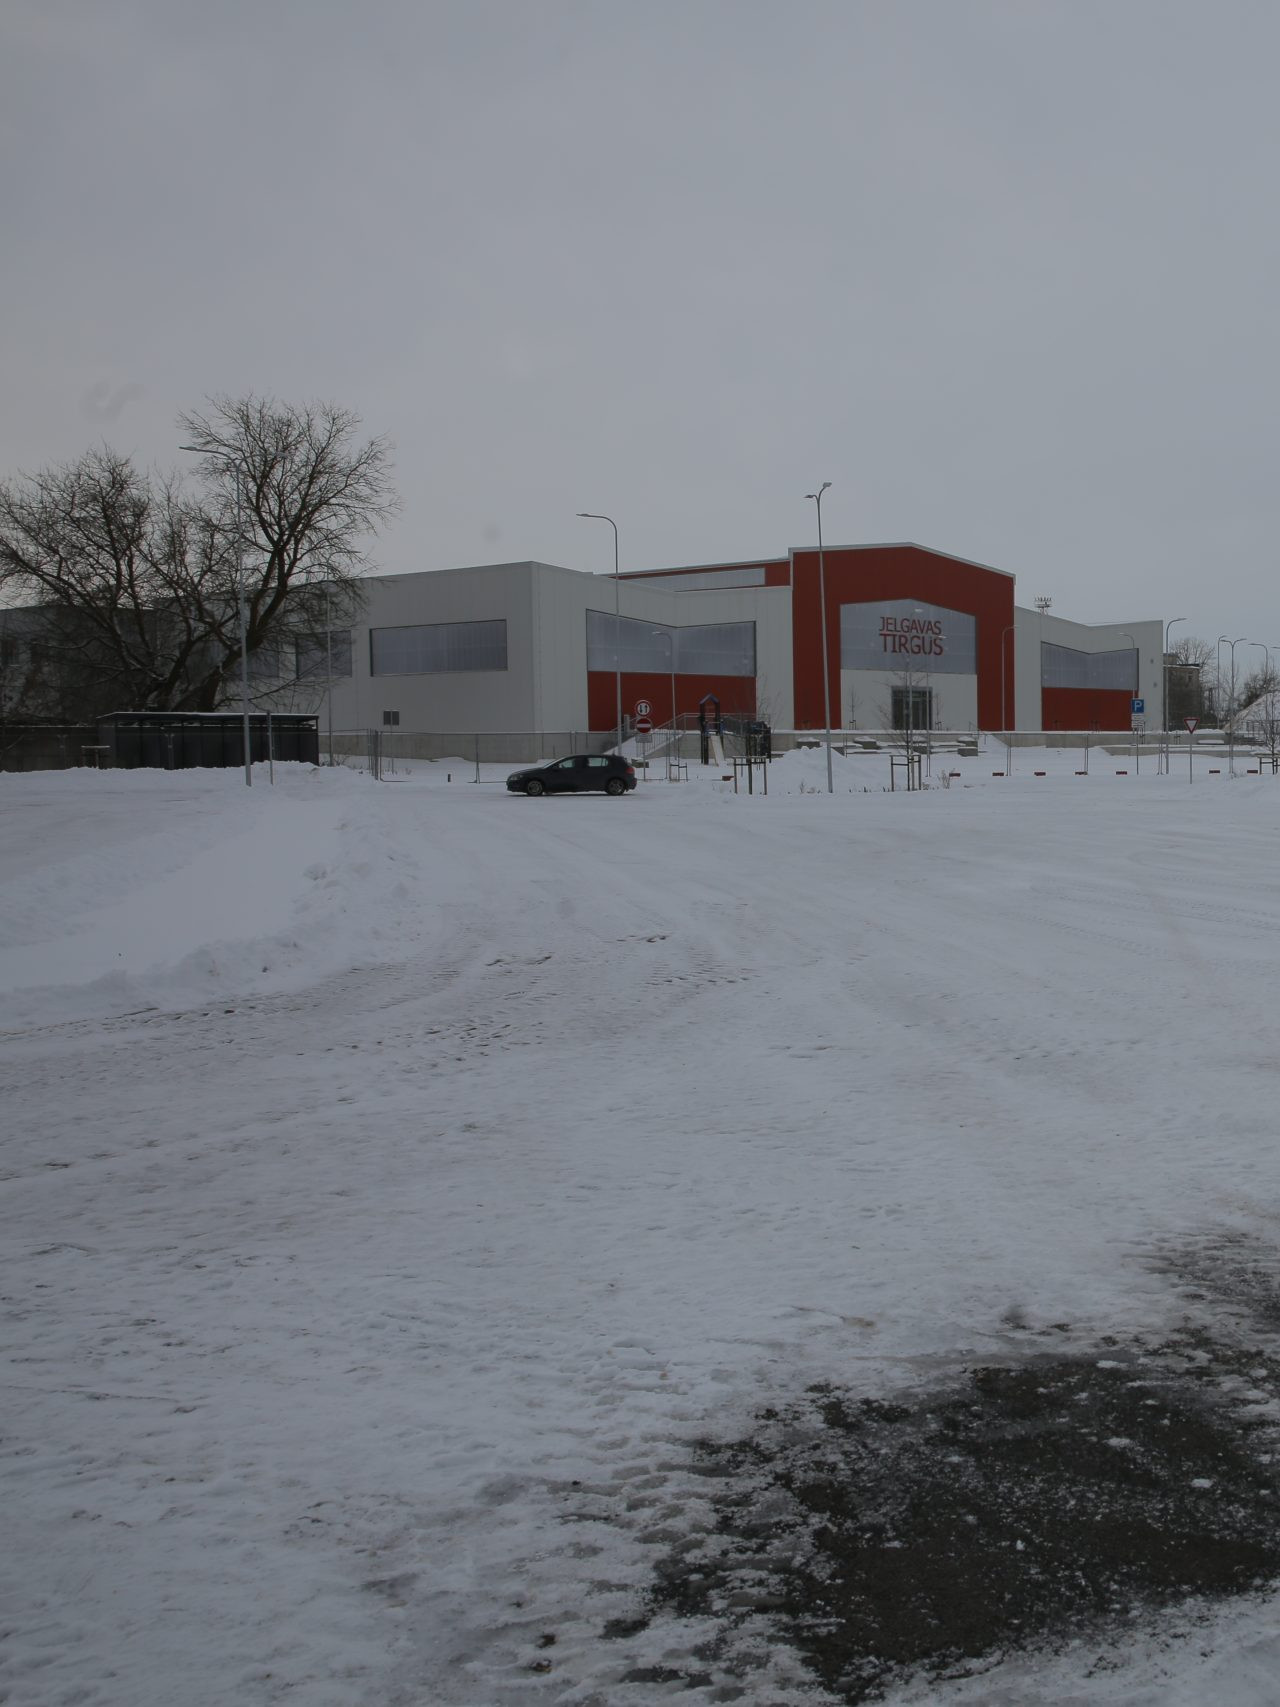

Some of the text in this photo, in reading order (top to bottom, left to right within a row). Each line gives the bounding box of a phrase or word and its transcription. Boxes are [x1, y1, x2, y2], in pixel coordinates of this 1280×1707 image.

[879, 617, 942, 635] JELGAVAS
[879, 633, 943, 655] TIRGUS
[1134, 700, 1142, 712] P
